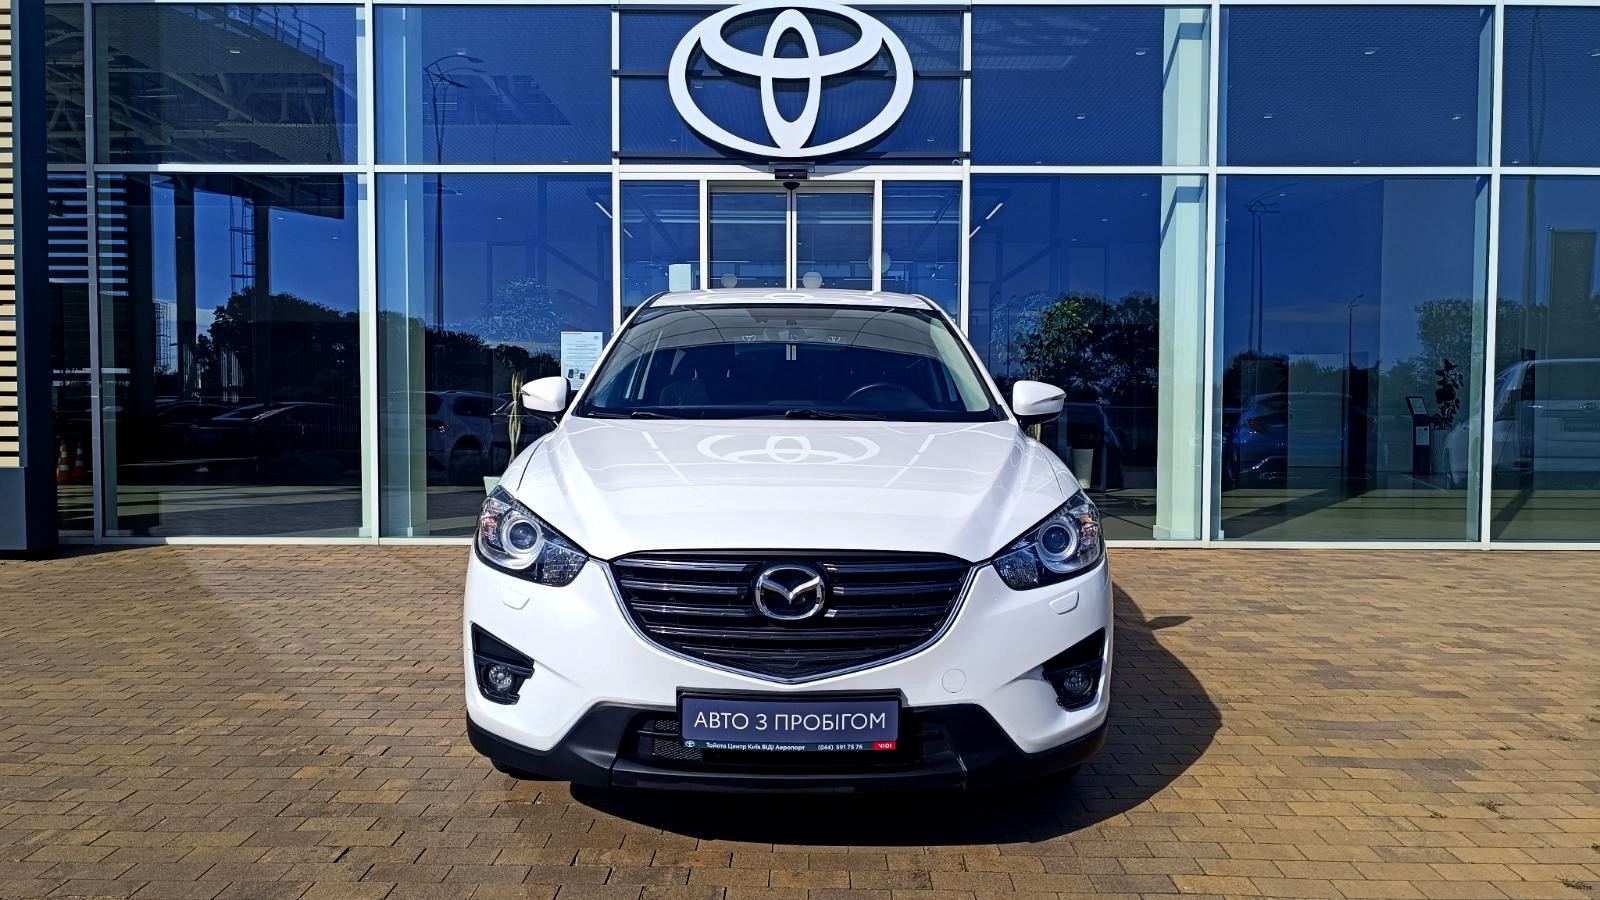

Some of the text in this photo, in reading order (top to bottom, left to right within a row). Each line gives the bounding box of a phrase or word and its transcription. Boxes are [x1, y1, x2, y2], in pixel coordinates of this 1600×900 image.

[693, 711, 886, 731] АВТО З ПРОБІГОМ
[727, 743, 747, 751] Центр
[775, 744, 806, 752] Аеропорт
